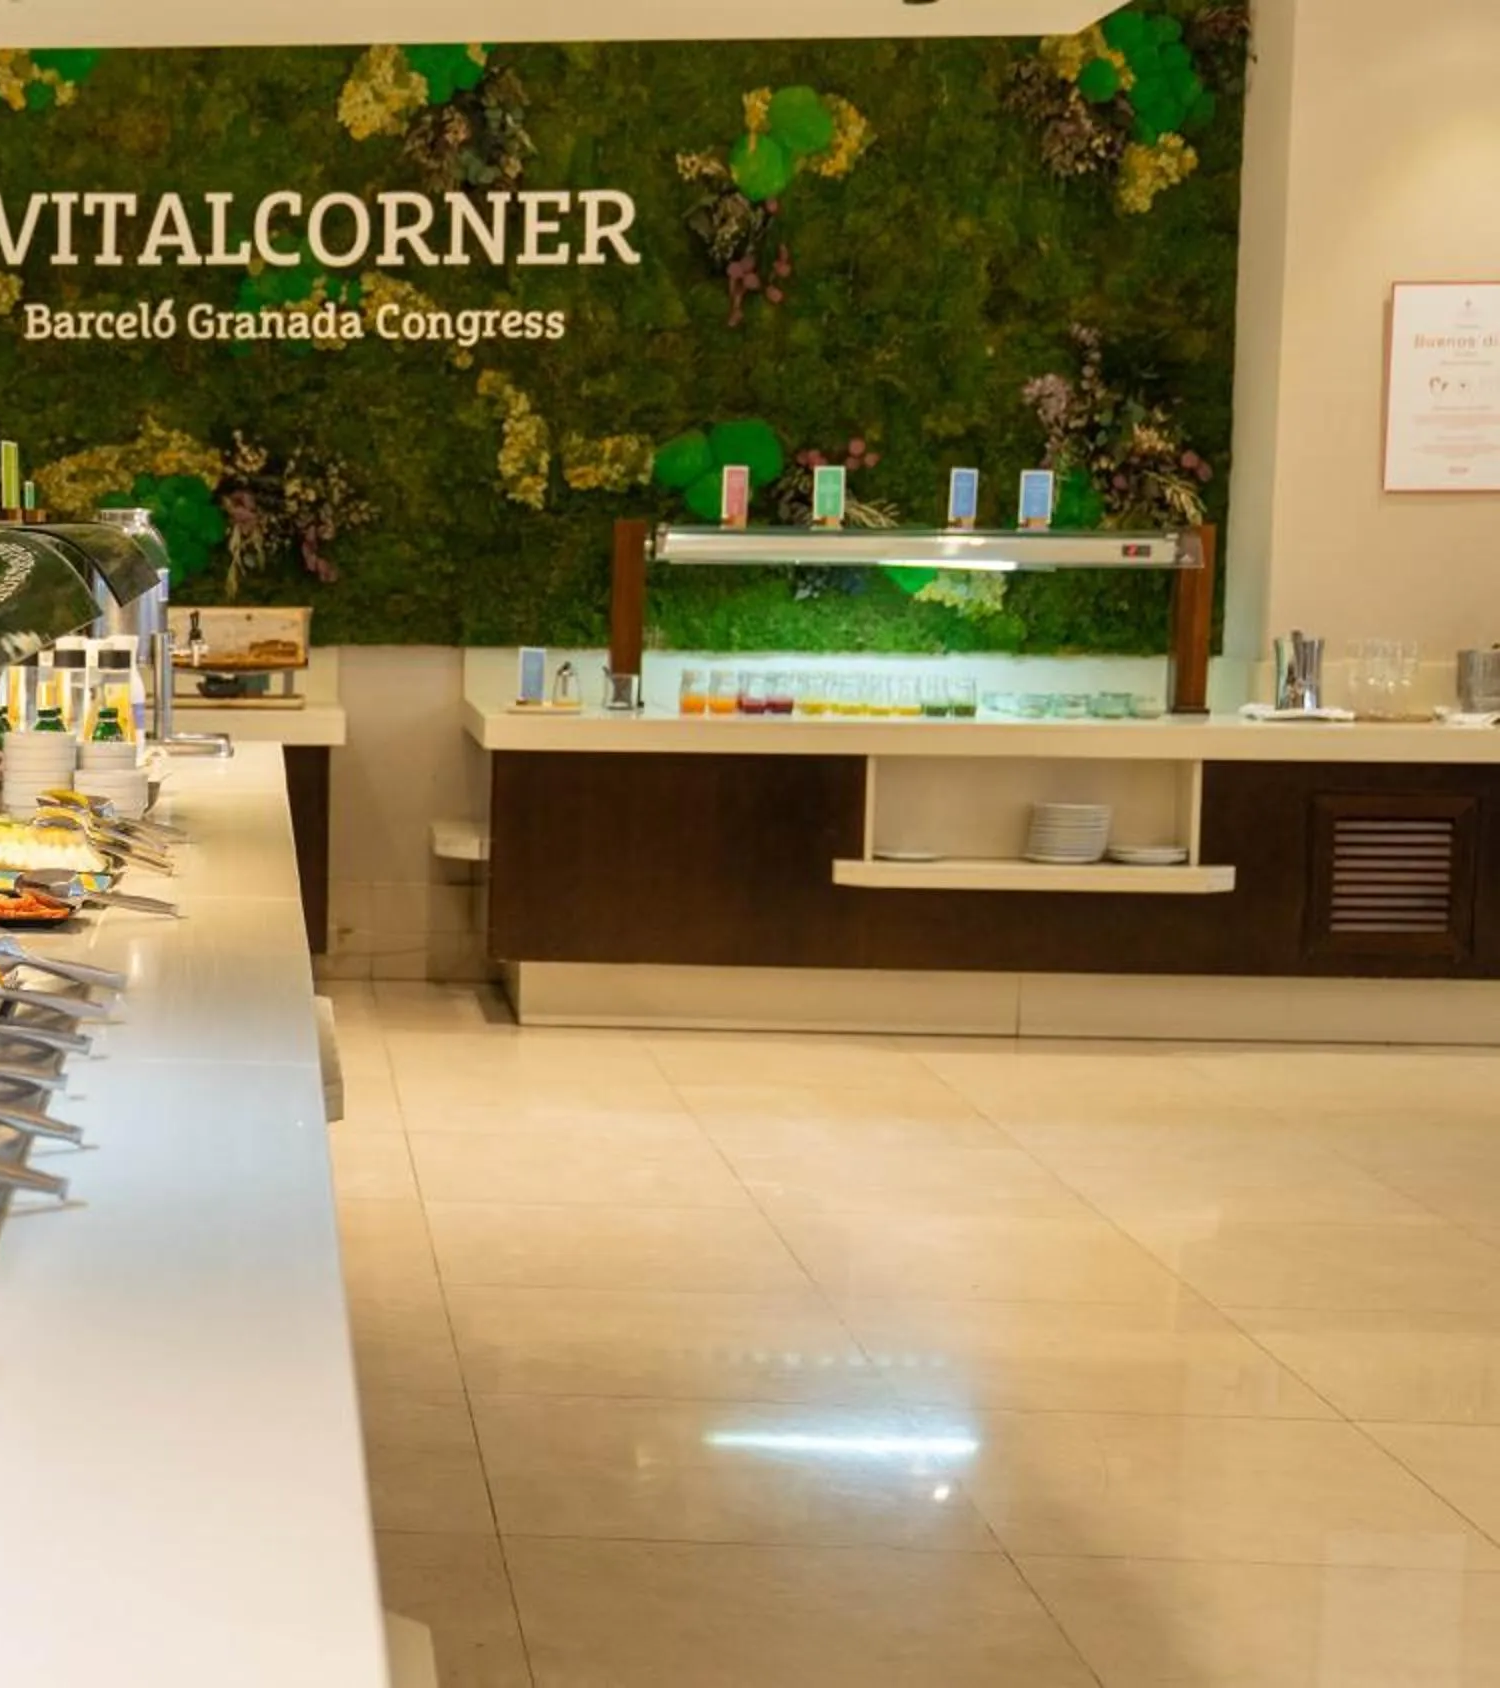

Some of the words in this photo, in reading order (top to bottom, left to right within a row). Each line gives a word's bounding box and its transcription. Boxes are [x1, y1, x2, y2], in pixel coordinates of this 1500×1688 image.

[24, 298, 176, 339] Barceló
[187, 302, 365, 339] Granada
[376, 303, 566, 346] Congress
